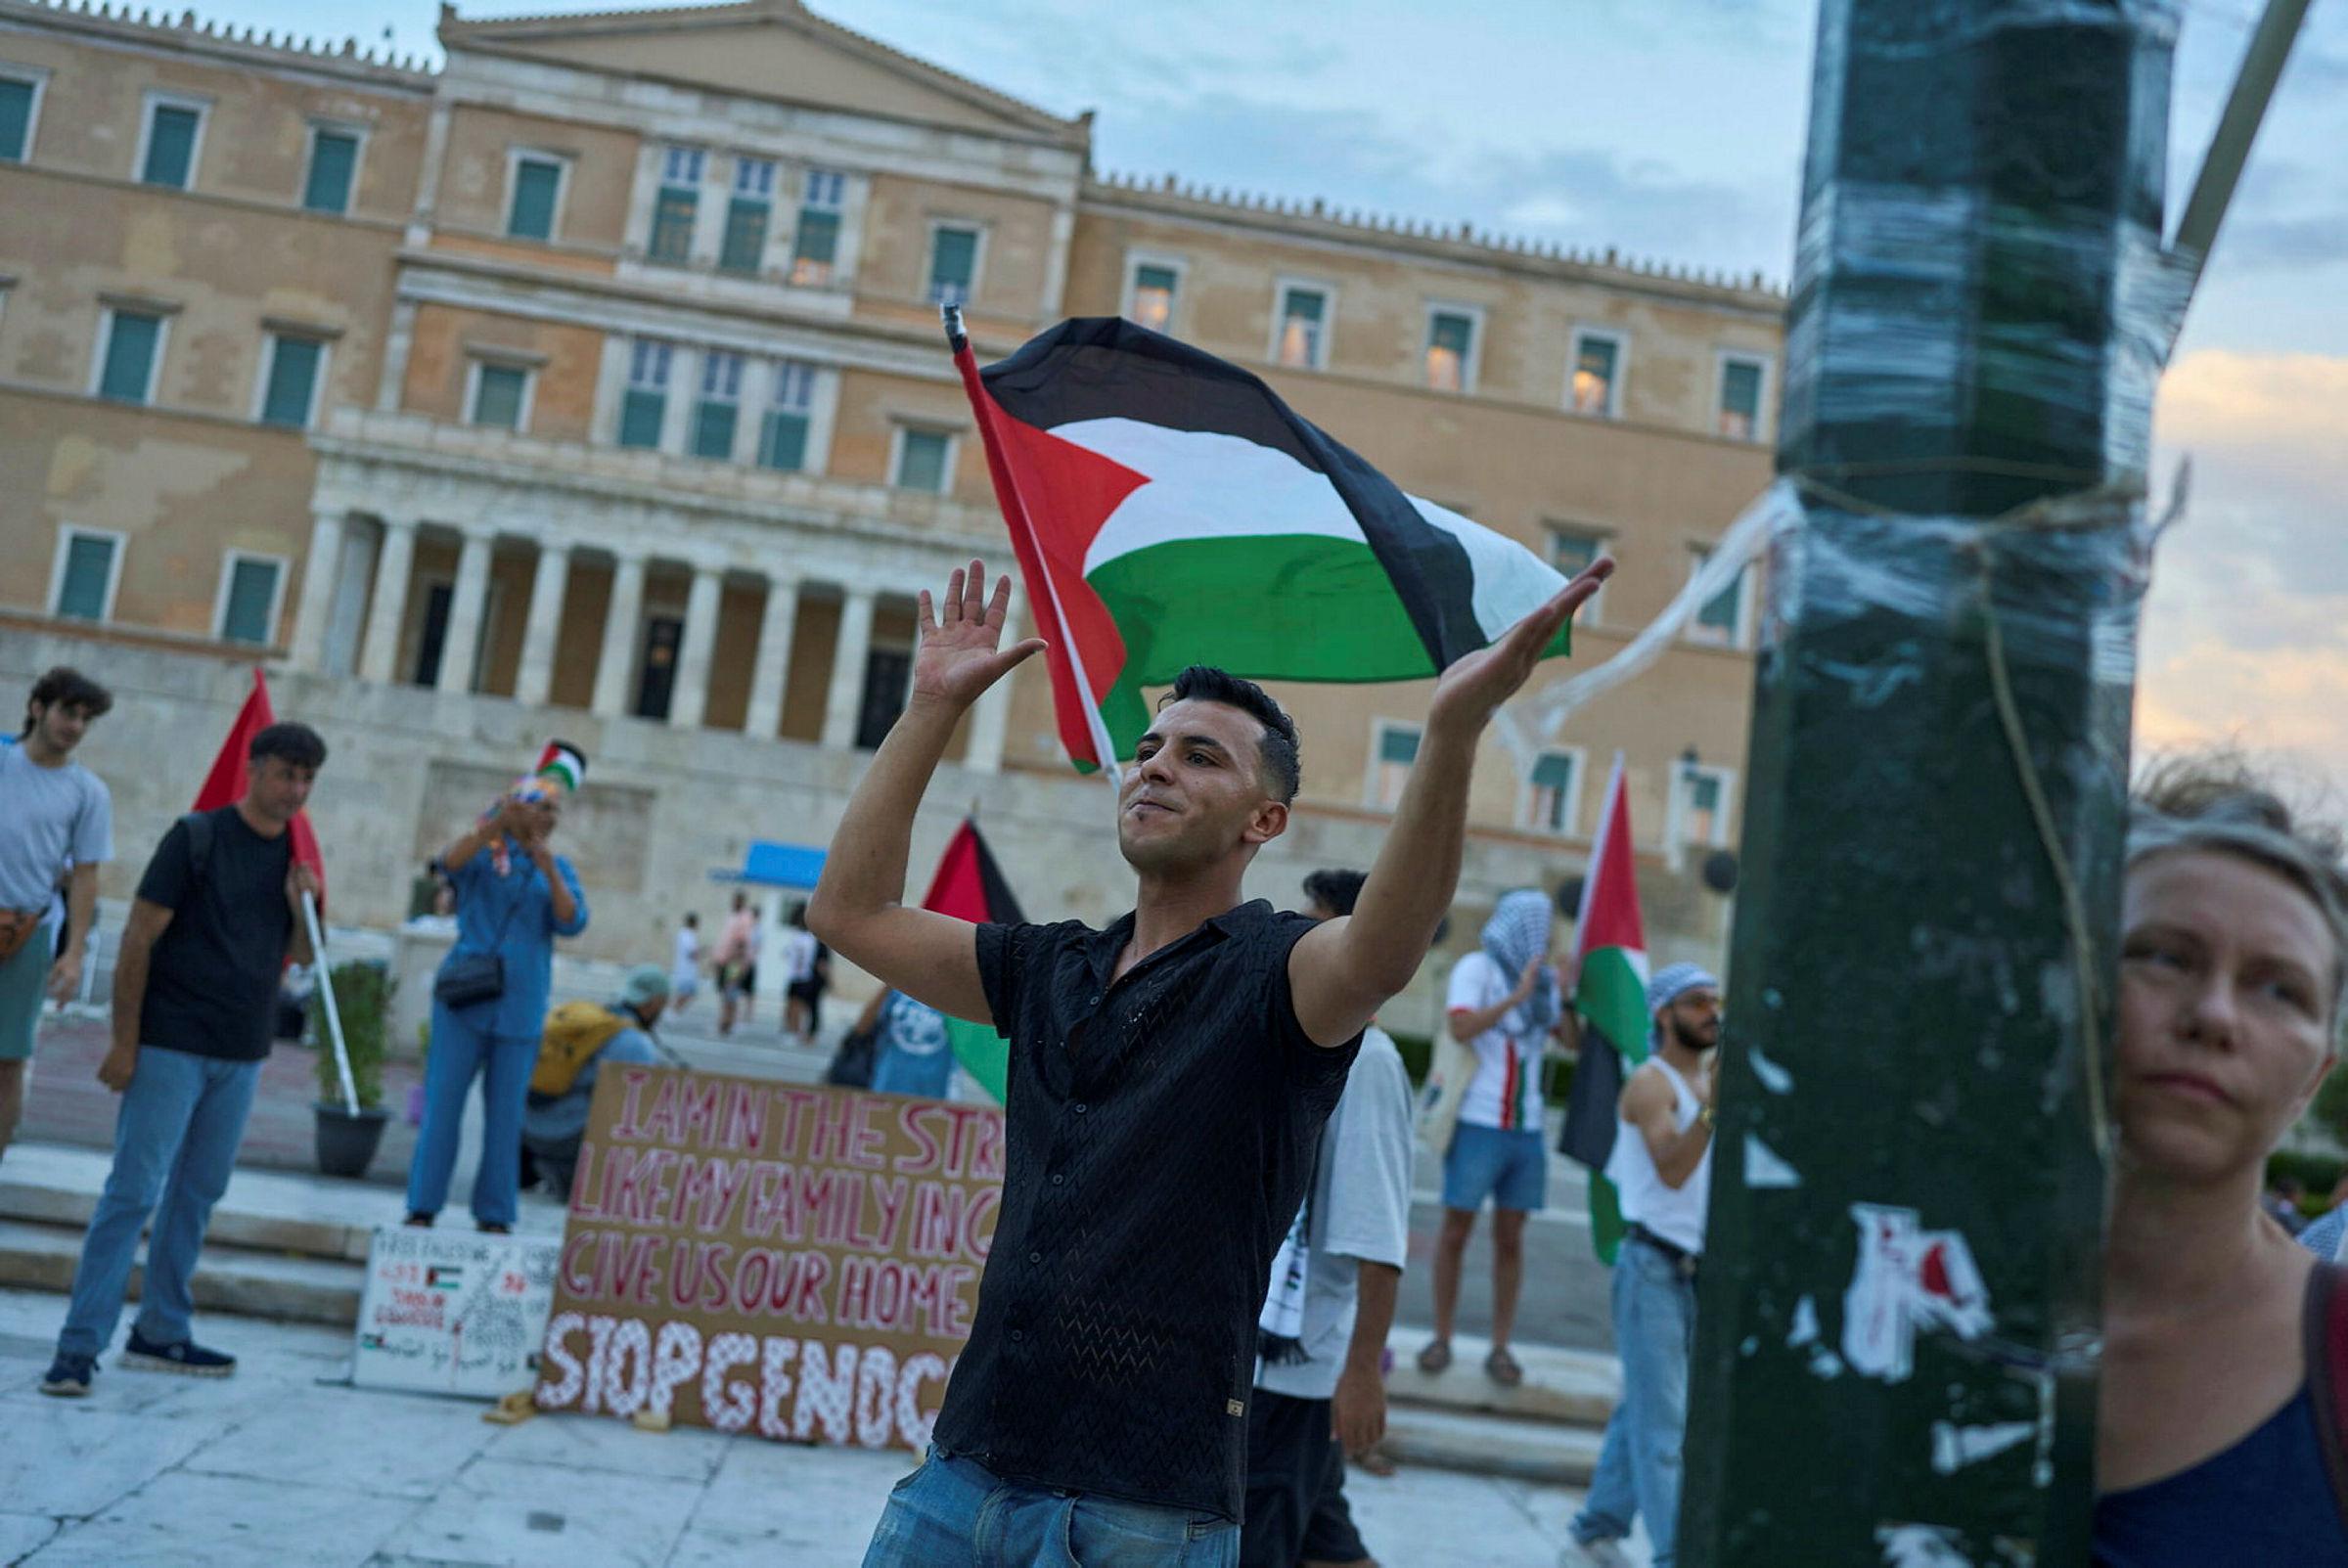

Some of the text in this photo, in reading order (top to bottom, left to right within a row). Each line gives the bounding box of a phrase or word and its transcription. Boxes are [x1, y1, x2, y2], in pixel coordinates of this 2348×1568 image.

[610, 1070, 653, 1141] I
[643, 1075, 723, 1149] AM
[774, 1089, 892, 1171] THE
[570, 1142, 679, 1227] LIKE
[668, 1153, 750, 1235] MY
[741, 1158, 908, 1253] FAMILY
[558, 1229, 670, 1306] GIVE
[668, 1236, 733, 1314] US
[733, 1245, 832, 1325] OUR
[835, 1252, 977, 1340] HOME
[535, 1311, 703, 1417] STOP
